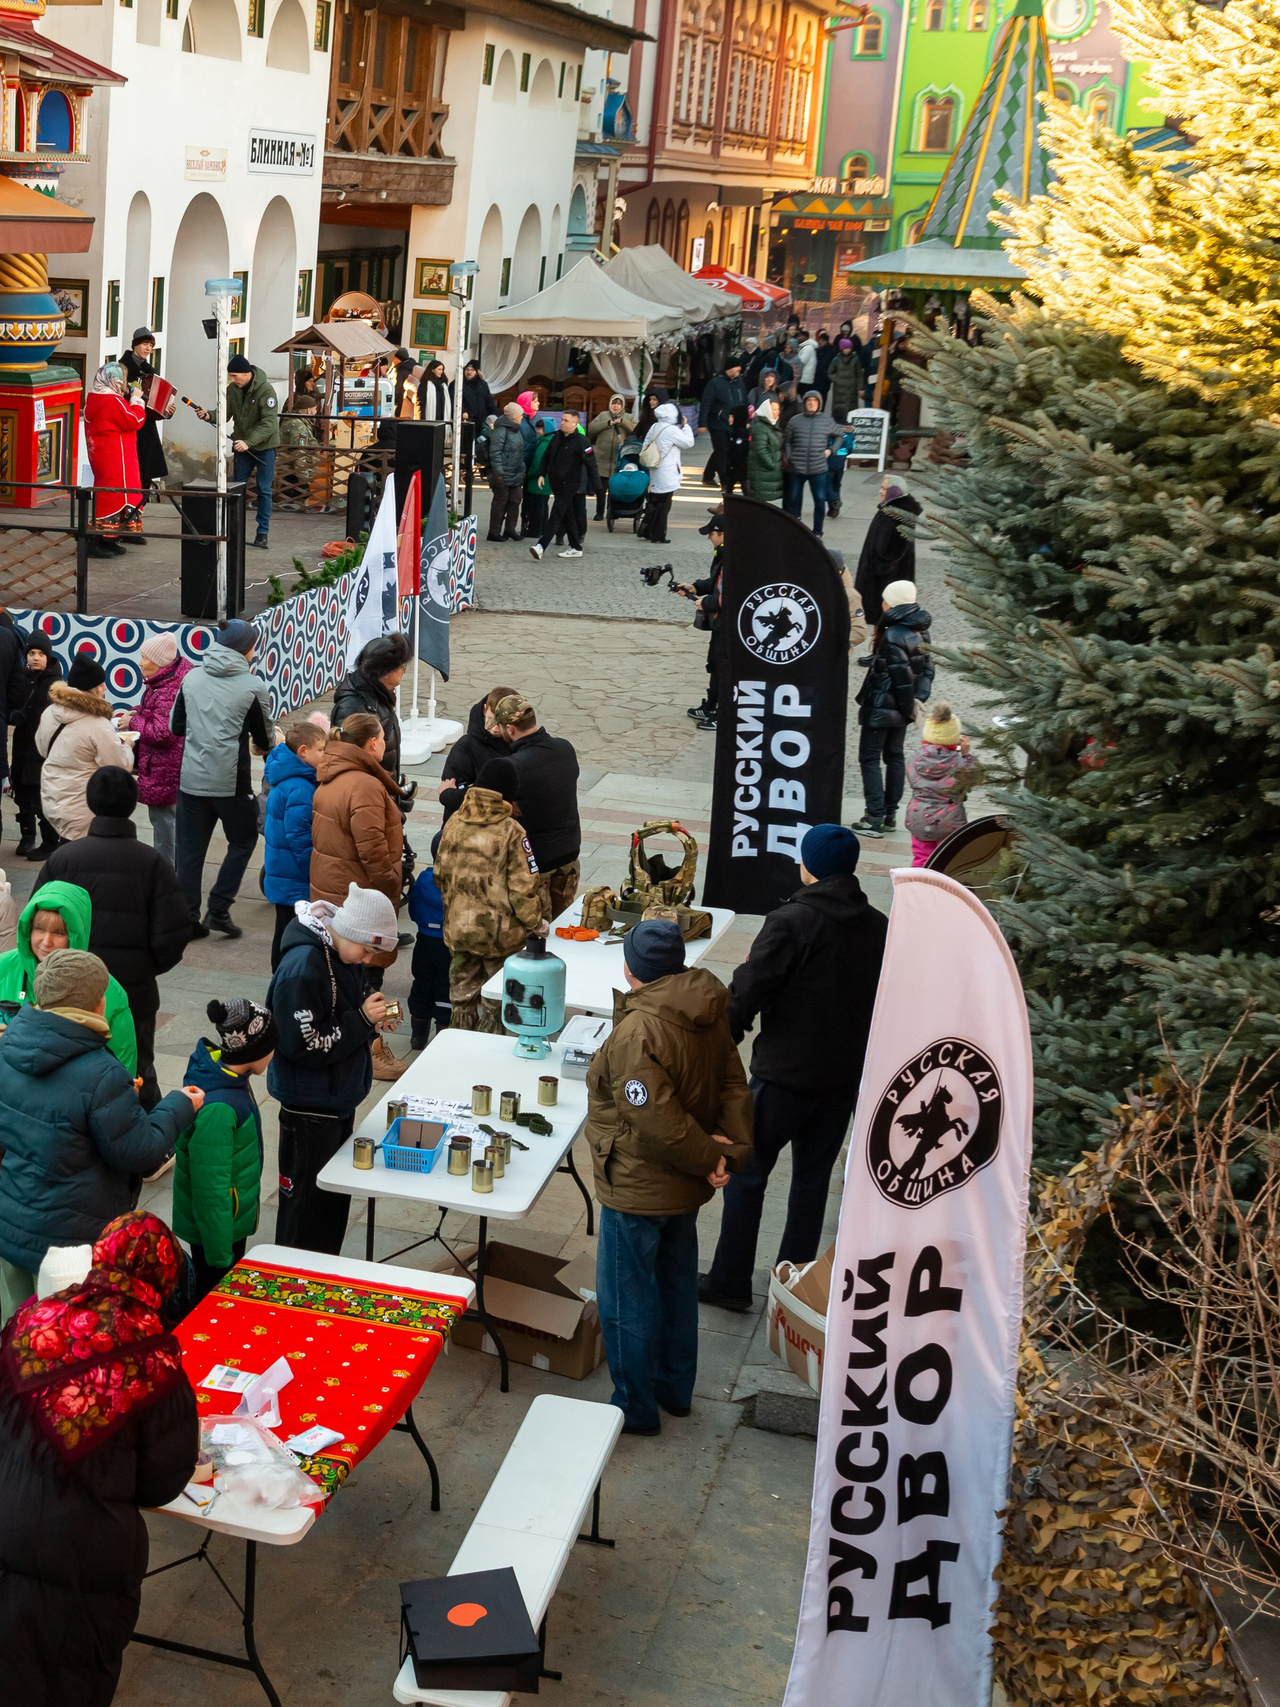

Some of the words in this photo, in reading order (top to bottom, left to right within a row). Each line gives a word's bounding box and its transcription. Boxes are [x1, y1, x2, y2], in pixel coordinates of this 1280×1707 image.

[745, 585, 816, 614] РУССКАЯ
[745, 636, 810, 662] ОБЩИНА
[731, 680, 767, 858] РУССКИЙ
[766, 684, 813, 865] ДВОР
[886, 1043, 1000, 1105] РУССКАЯ
[876, 1152, 976, 1203] ОБЩИНА
[827, 1251, 896, 1636] РУССКИЙ
[888, 1244, 964, 1631] ДВОР
